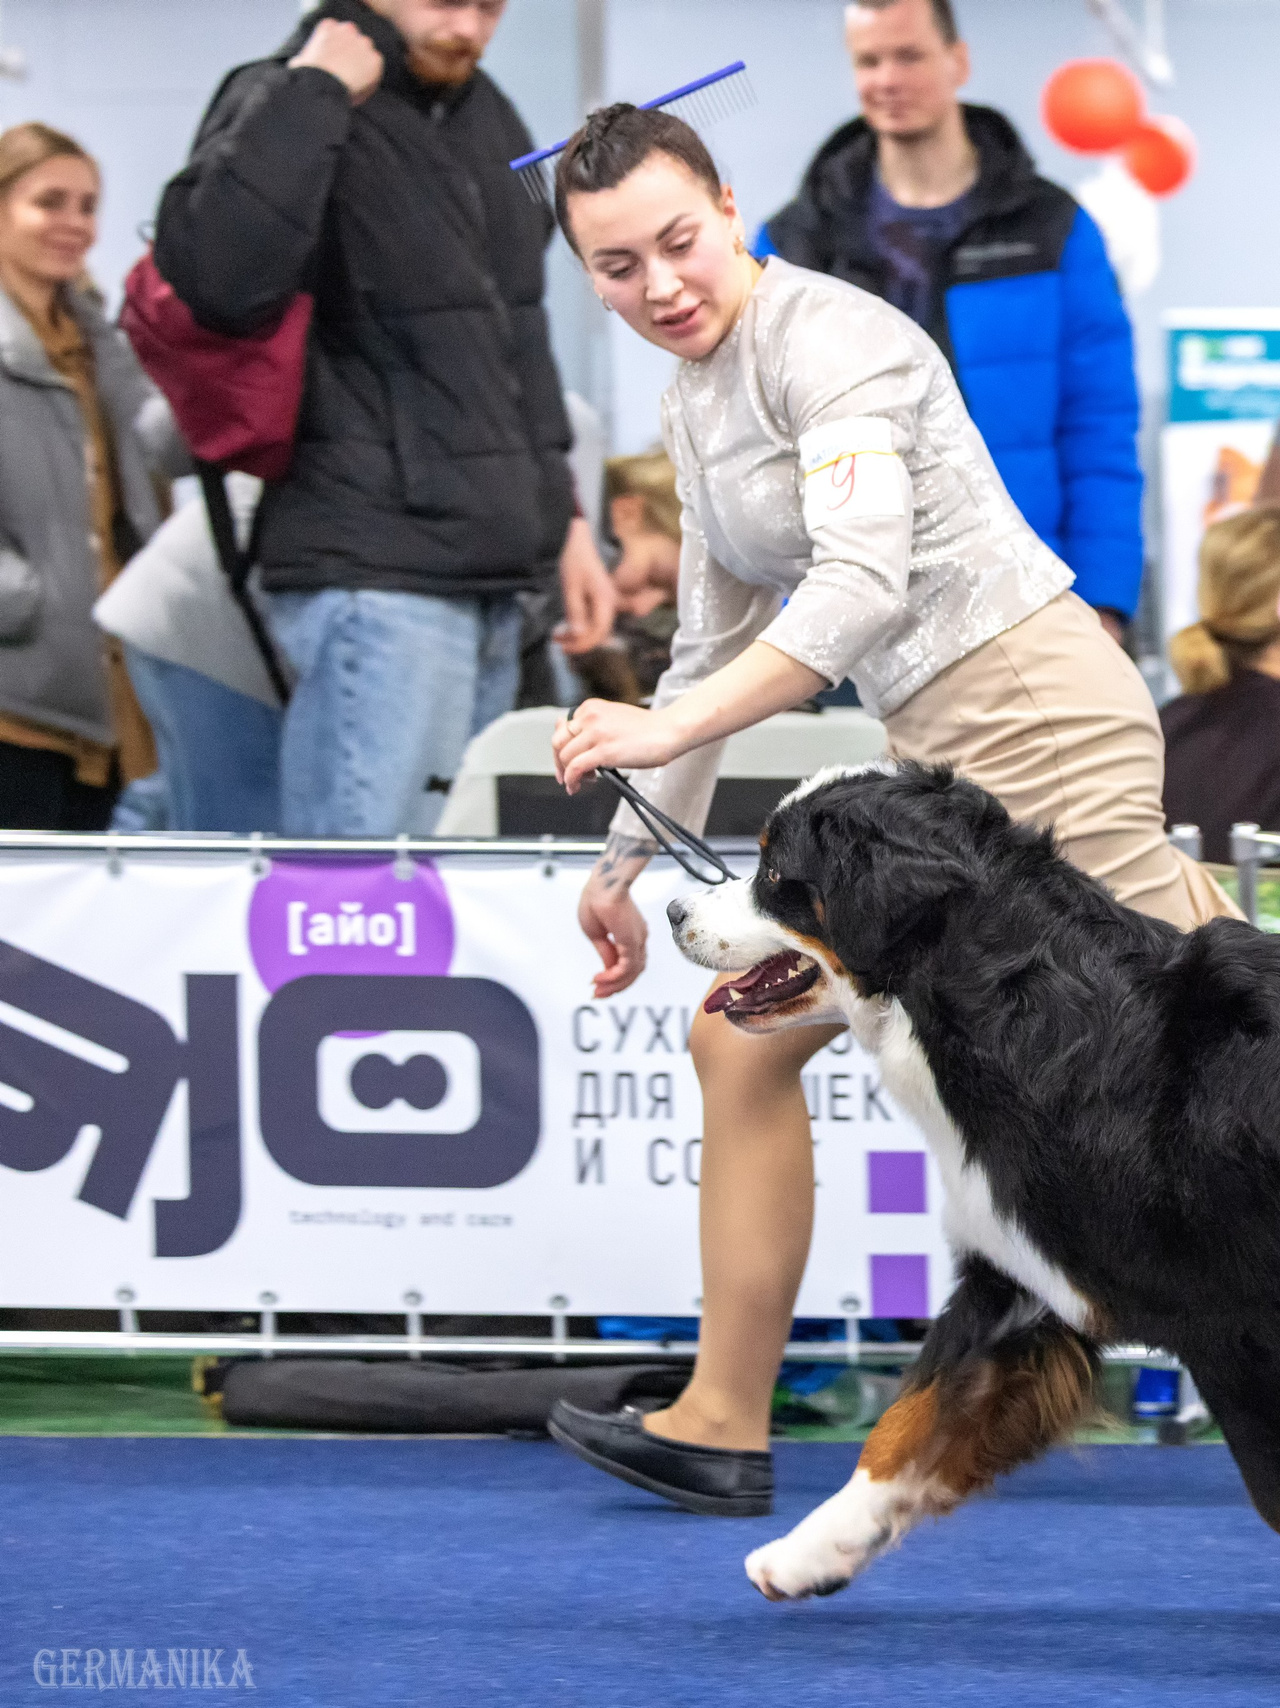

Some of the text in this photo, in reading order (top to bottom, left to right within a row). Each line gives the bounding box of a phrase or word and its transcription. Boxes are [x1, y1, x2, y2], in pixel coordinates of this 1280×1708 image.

[288, 900, 416, 957] [айо]
[572, 1005, 690, 1053] СУХ
[572, 1071, 674, 1129] ДЛЯ
[576, 1138, 604, 1186] И
[420, 1213, 454, 1227] and
